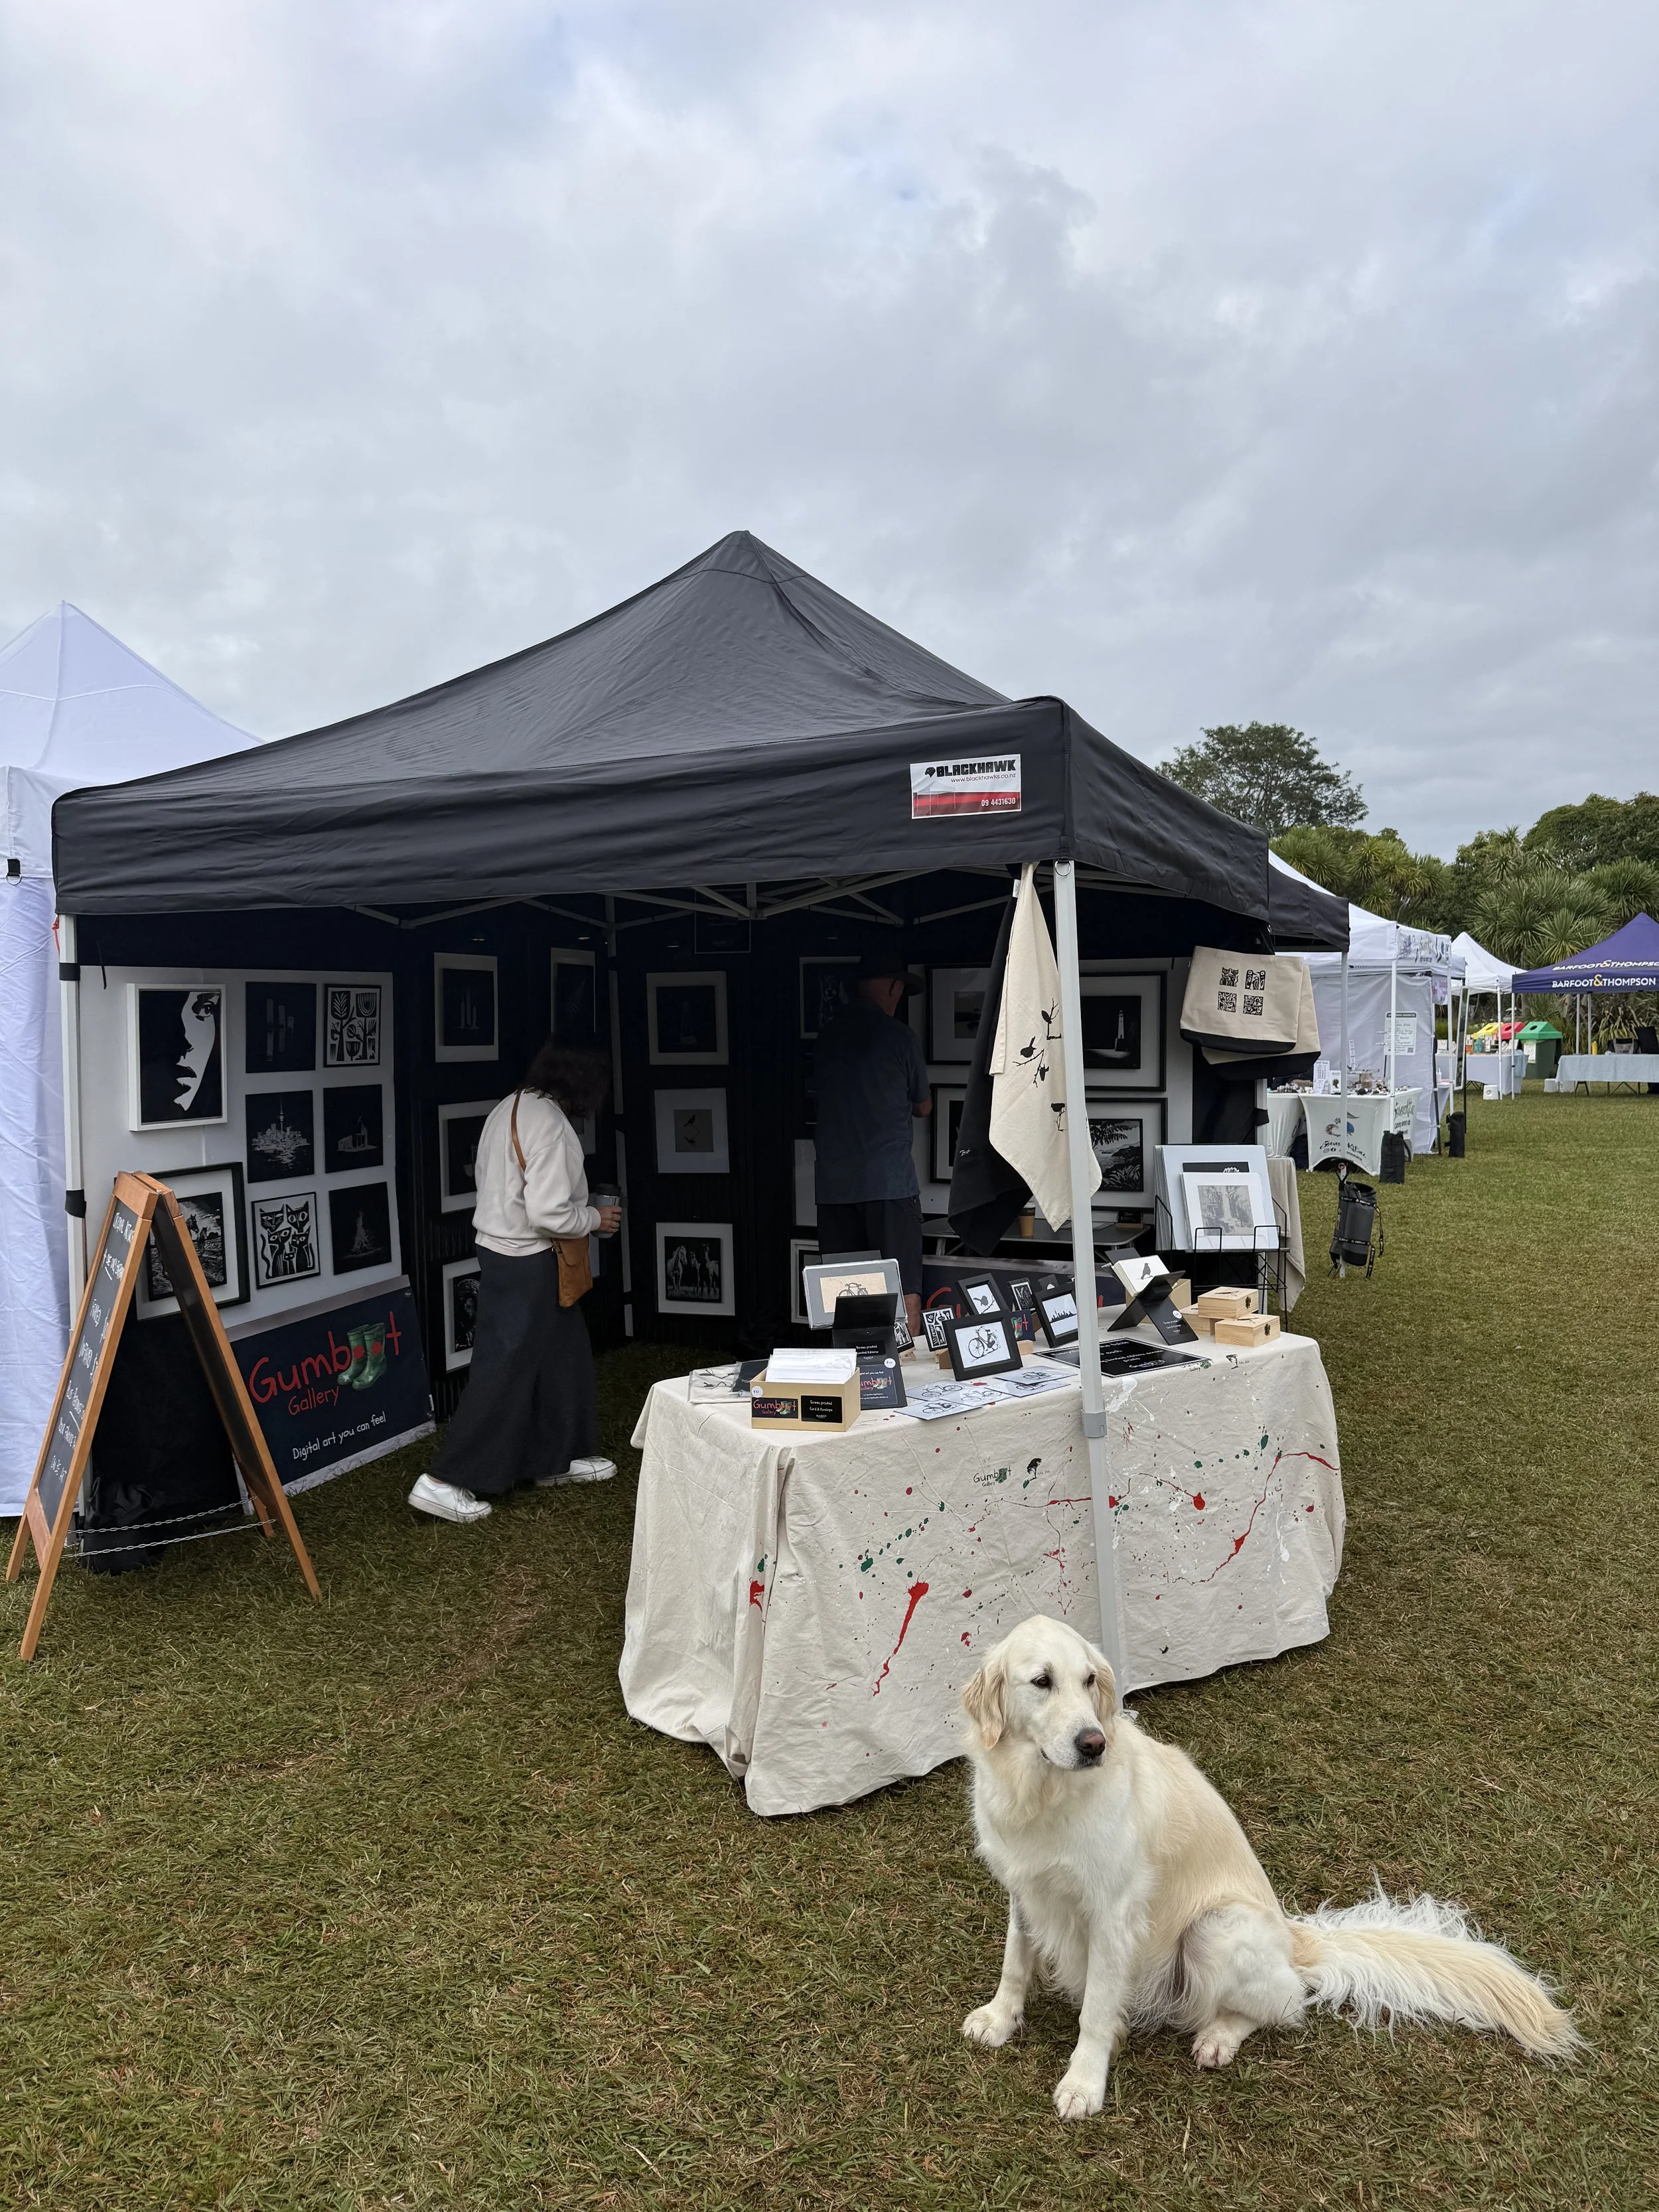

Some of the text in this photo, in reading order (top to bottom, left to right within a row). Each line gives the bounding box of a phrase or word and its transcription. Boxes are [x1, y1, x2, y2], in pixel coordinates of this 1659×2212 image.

[936, 759, 1016, 778] BLACKHAWK
[991, 798, 1016, 806] 4431630
[250, 1311, 401, 1403] Gumboot
[860, 1376, 893, 1386] umboot
[287, 1386, 339, 1416] Gallery
[293, 1411, 386, 1461] Digital art you can feel
[973, 1465, 1012, 1483] Gumbt
